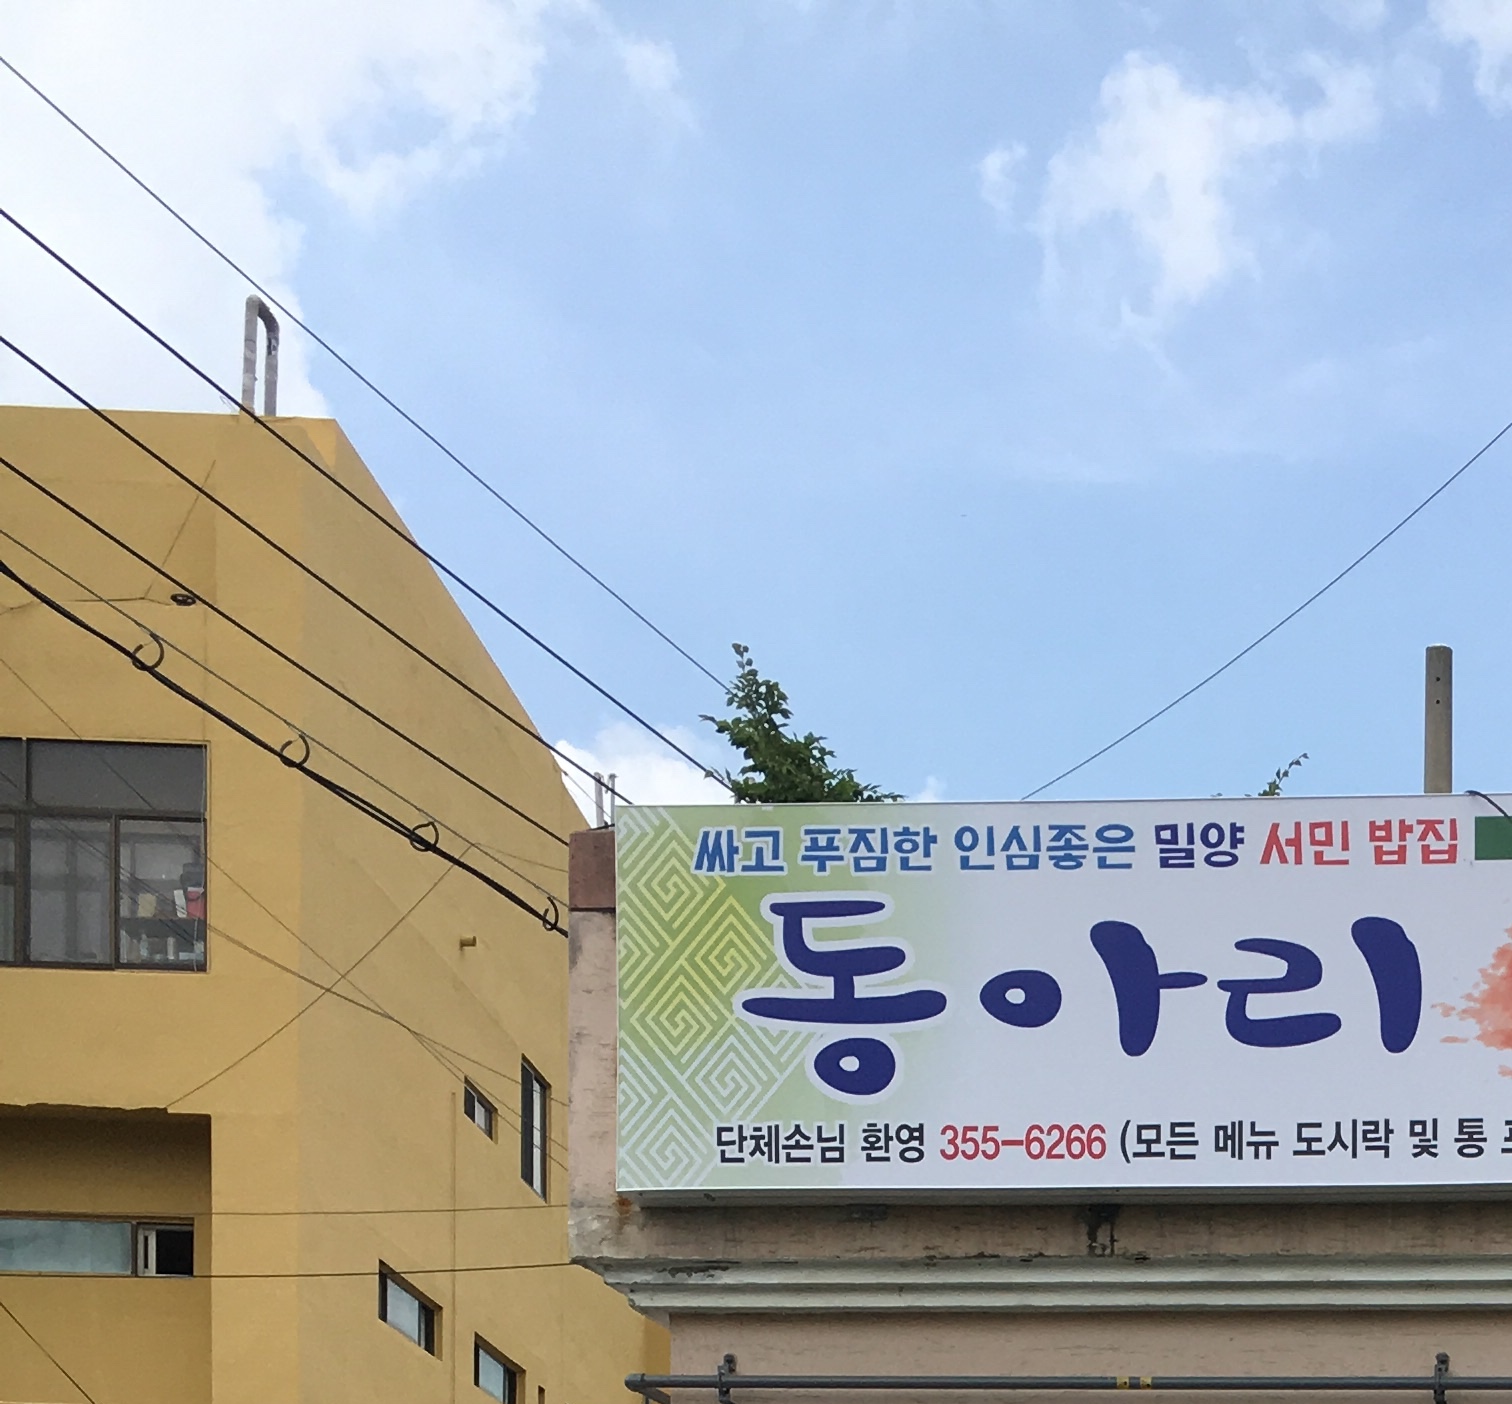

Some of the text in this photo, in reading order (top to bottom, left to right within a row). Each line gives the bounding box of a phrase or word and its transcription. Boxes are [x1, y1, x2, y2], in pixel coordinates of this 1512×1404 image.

[694, 817, 1459, 874] 싸고 푸짐한 인심좋은 밀양 서민 밥집
[742, 900, 1424, 1096] 동아리
[717, 1124, 846, 1165] 단체손님
[860, 1124, 926, 1165] 환영
[939, 1124, 1107, 1163] 355-6266
[1119, 1120, 1201, 1165] (모든
[1214, 1121, 1280, 1162] 메뉴
[1292, 1119, 1395, 1161] 도시락
[1408, 1119, 1440, 1159] 및
[1454, 1118, 1490, 1159] 통
